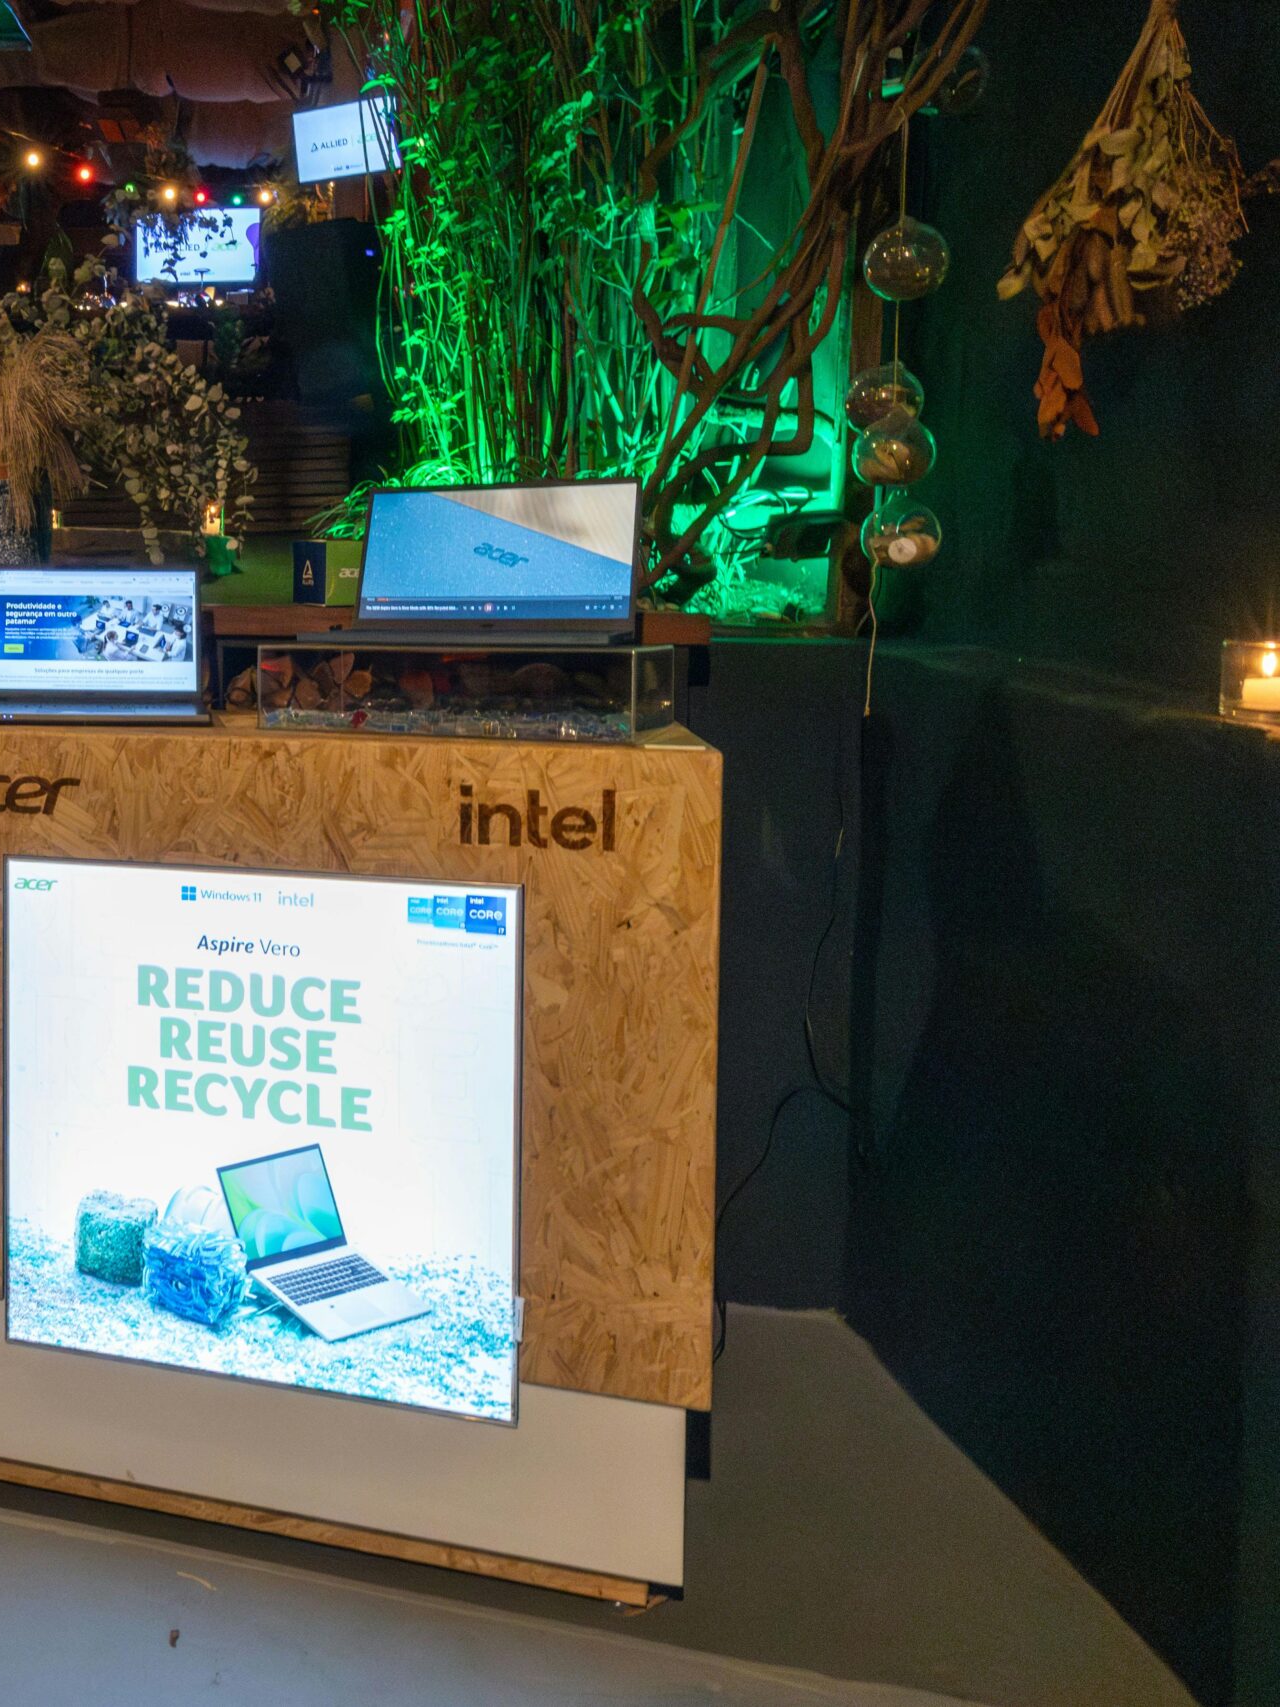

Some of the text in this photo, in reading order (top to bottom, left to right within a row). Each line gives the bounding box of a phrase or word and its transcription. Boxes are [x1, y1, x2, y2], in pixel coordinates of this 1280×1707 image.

[320, 138, 348, 149] ALLIED
[473, 543, 529, 568] acer
[5, 611, 43, 619] segurança
[6, 602, 56, 610] Produtividade
[460, 785, 615, 851] intel
[14, 877, 58, 891] acer
[200, 889, 262, 902] Windows 11
[278, 891, 314, 907] intel
[197, 934, 300, 958] Aspire Vero
[137, 964, 362, 1024] REDUCE
[160, 1016, 337, 1075] REUSE
[127, 1065, 372, 1132] RECYCLE
